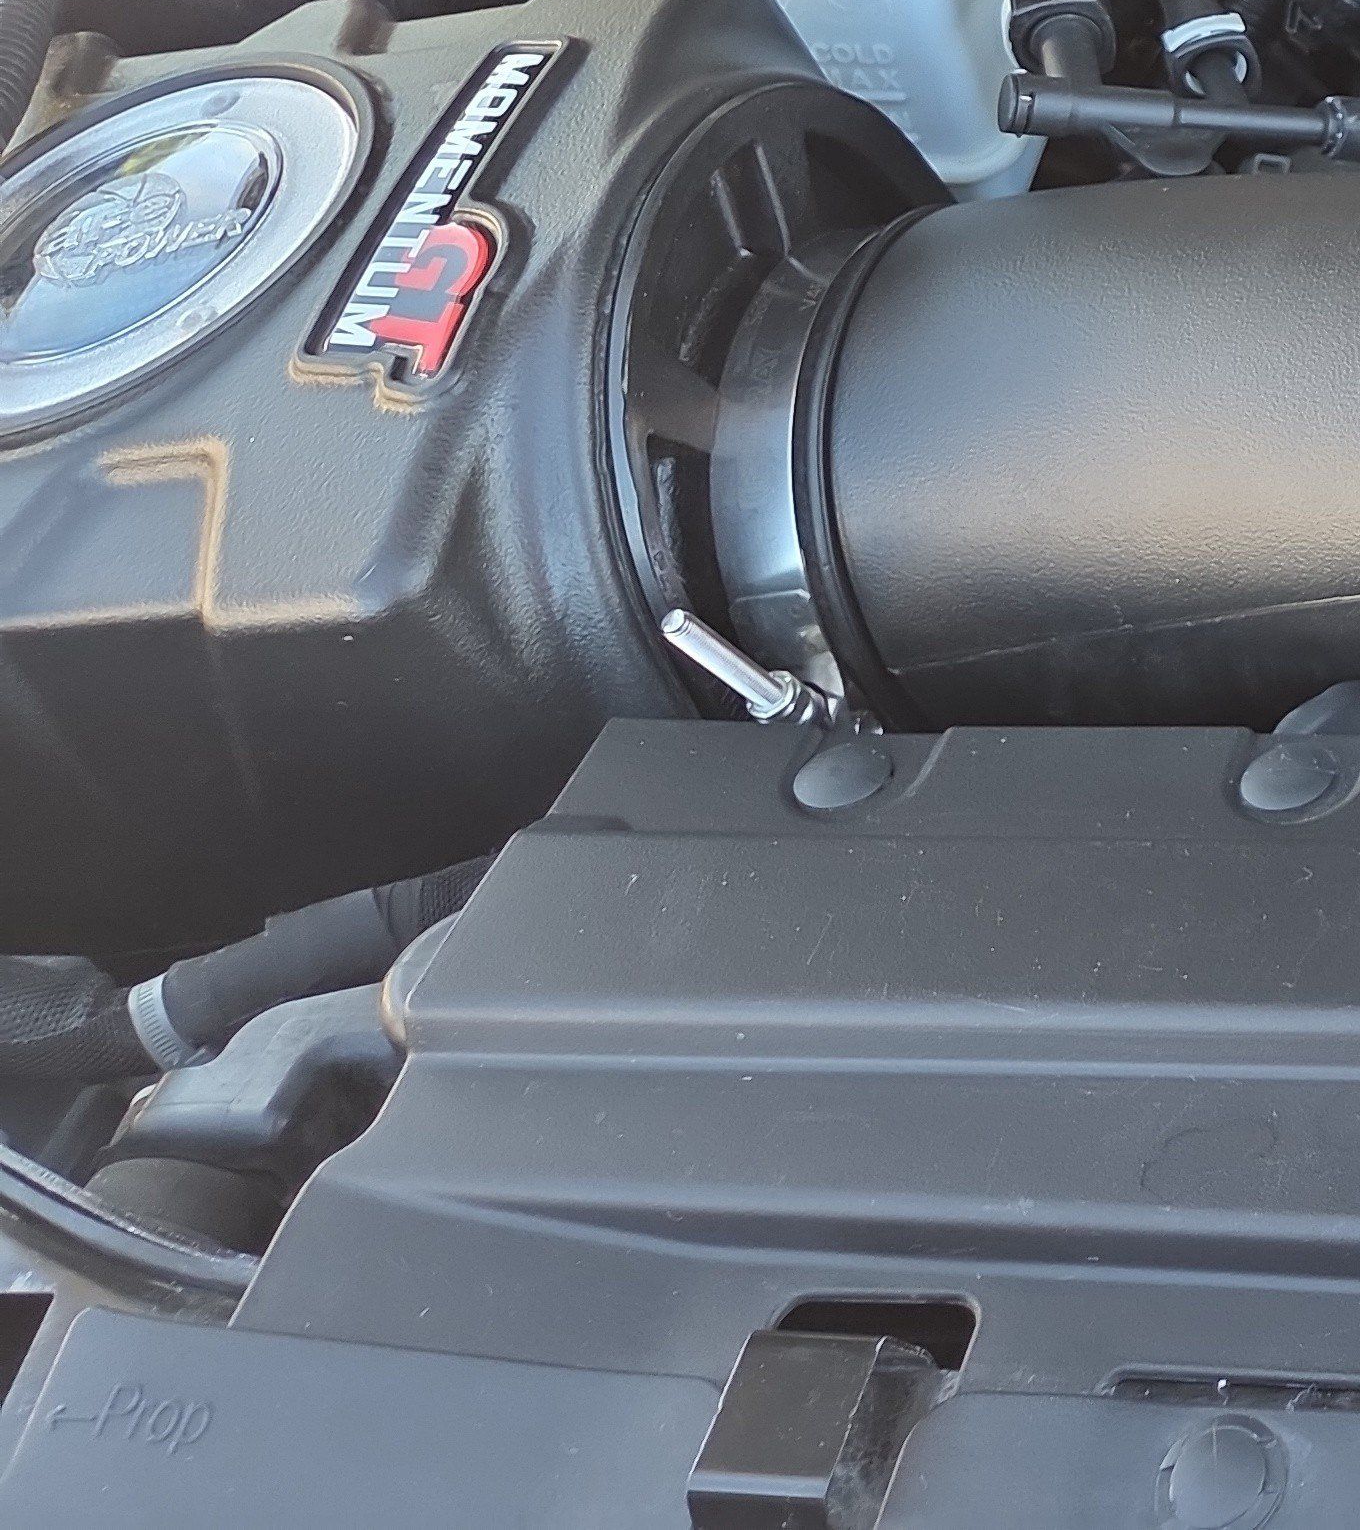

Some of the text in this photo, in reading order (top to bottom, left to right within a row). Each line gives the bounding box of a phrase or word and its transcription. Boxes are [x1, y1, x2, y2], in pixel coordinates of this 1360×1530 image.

[329, 53, 543, 347] MOMENTUM
[370, 222, 492, 377] GT
[91, 1382, 212, 1454] Prop
